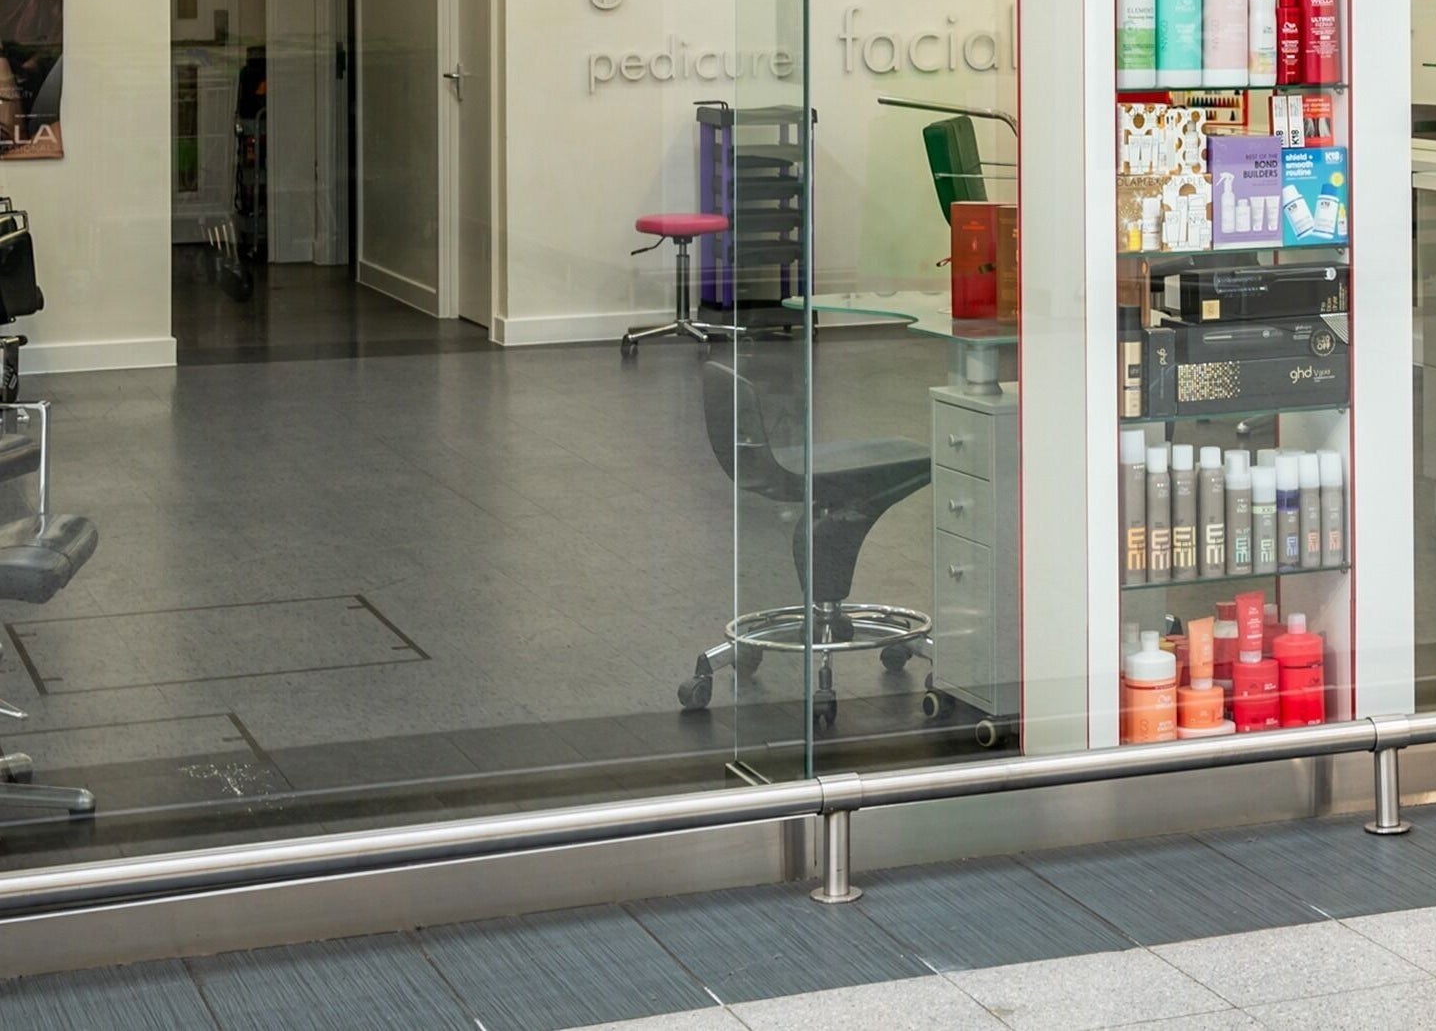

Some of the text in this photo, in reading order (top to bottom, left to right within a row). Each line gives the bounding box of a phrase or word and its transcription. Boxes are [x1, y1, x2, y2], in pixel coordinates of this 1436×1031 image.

[589, 36, 793, 93] pedicure
[1254, 160, 1278, 169] BOND
[1243, 170, 1278, 179] BUILDERS
[1289, 366, 1312, 384] ghd
